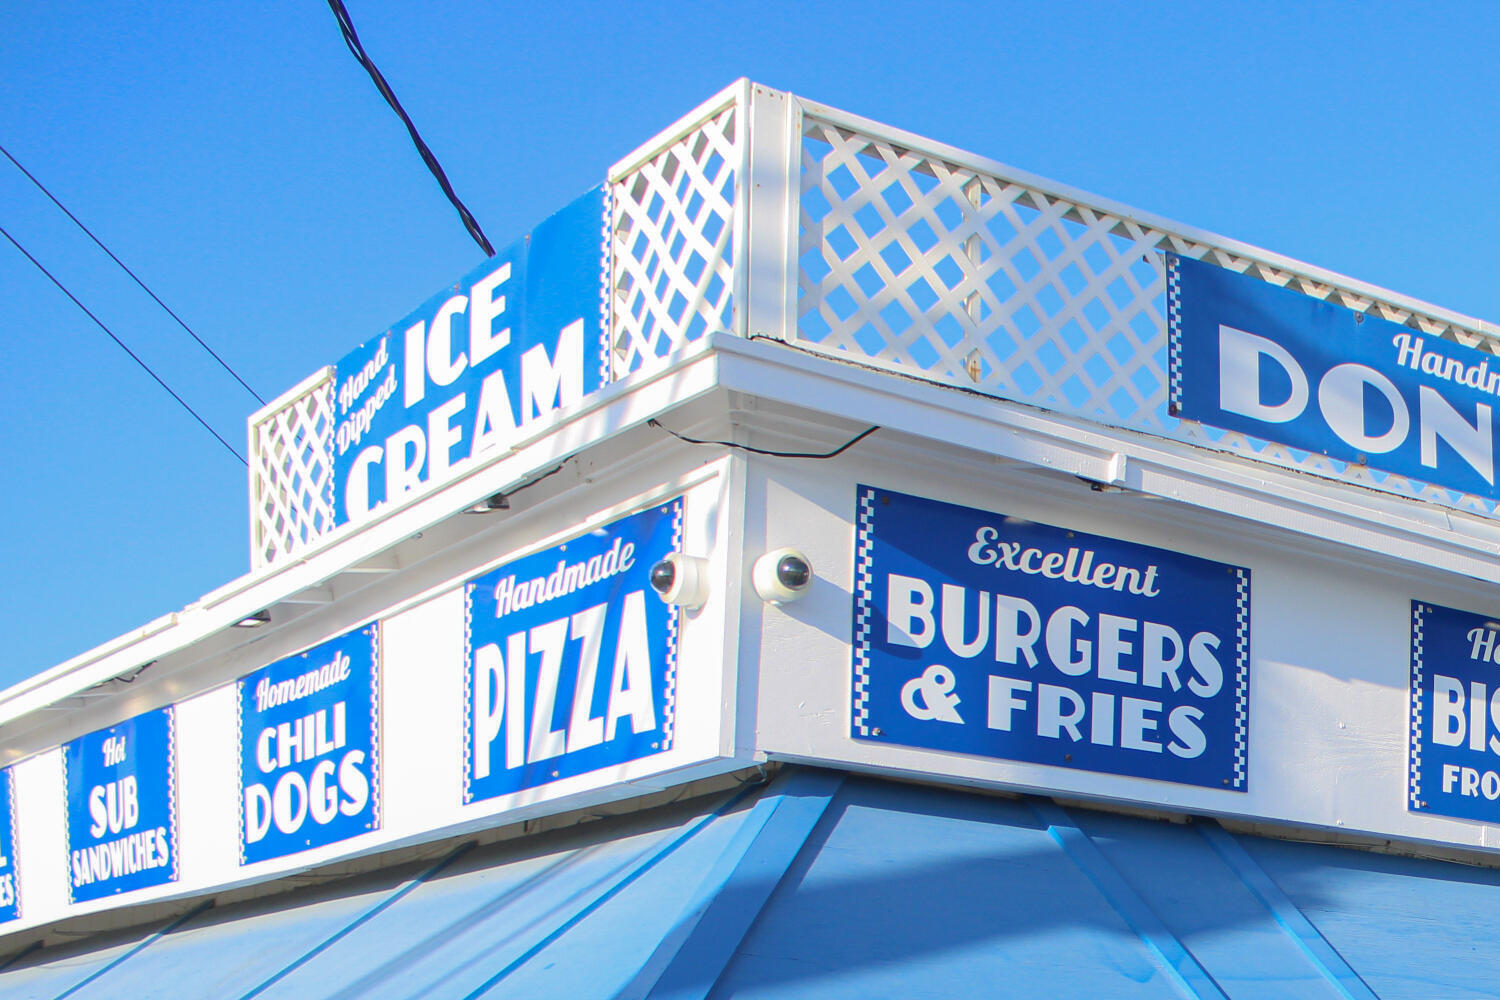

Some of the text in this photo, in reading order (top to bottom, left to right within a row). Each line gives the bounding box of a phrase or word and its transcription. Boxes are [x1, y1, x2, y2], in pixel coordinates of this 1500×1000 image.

[405, 262, 511, 408] ICE
[336, 364, 397, 456] Dipped
[339, 337, 388, 415] Hand
[346, 318, 584, 523] CREAM
[495, 537, 635, 618] Handmade
[968, 527, 1160, 597] Excellent
[888, 574, 1223, 698] BURGERS
[257, 651, 350, 712] Homemade
[474, 590, 656, 779] PIZZA
[901, 665, 1206, 759] & FRIES
[103, 736, 126, 767] Hot
[257, 701, 346, 773] CHILI
[89, 775, 139, 838] SUB
[245, 750, 369, 844] DOGS
[72, 827, 169, 887] SANDWICHES
